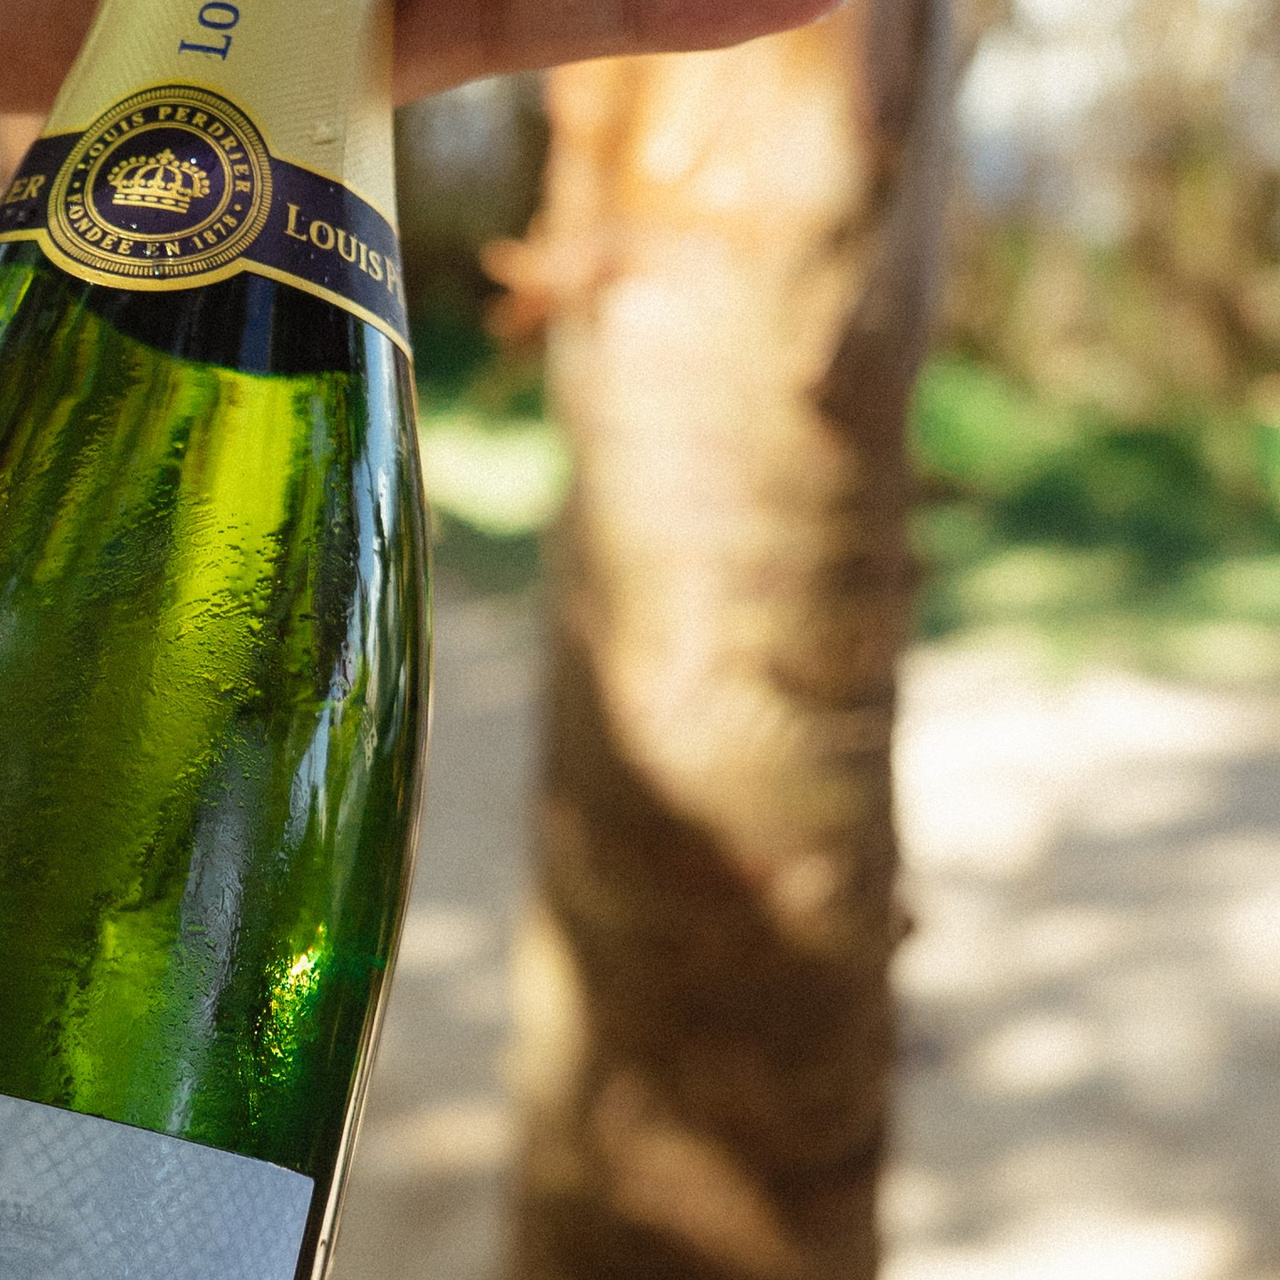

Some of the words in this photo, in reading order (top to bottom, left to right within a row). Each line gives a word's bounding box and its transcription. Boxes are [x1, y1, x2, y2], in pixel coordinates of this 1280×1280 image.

[77, 111, 145, 171] LOUIS
[158, 105, 252, 194] PERDRIER
[147, 240, 180, 257] EN
[192, 214, 239, 251] 1878
[284, 202, 384, 281] LOUIS
